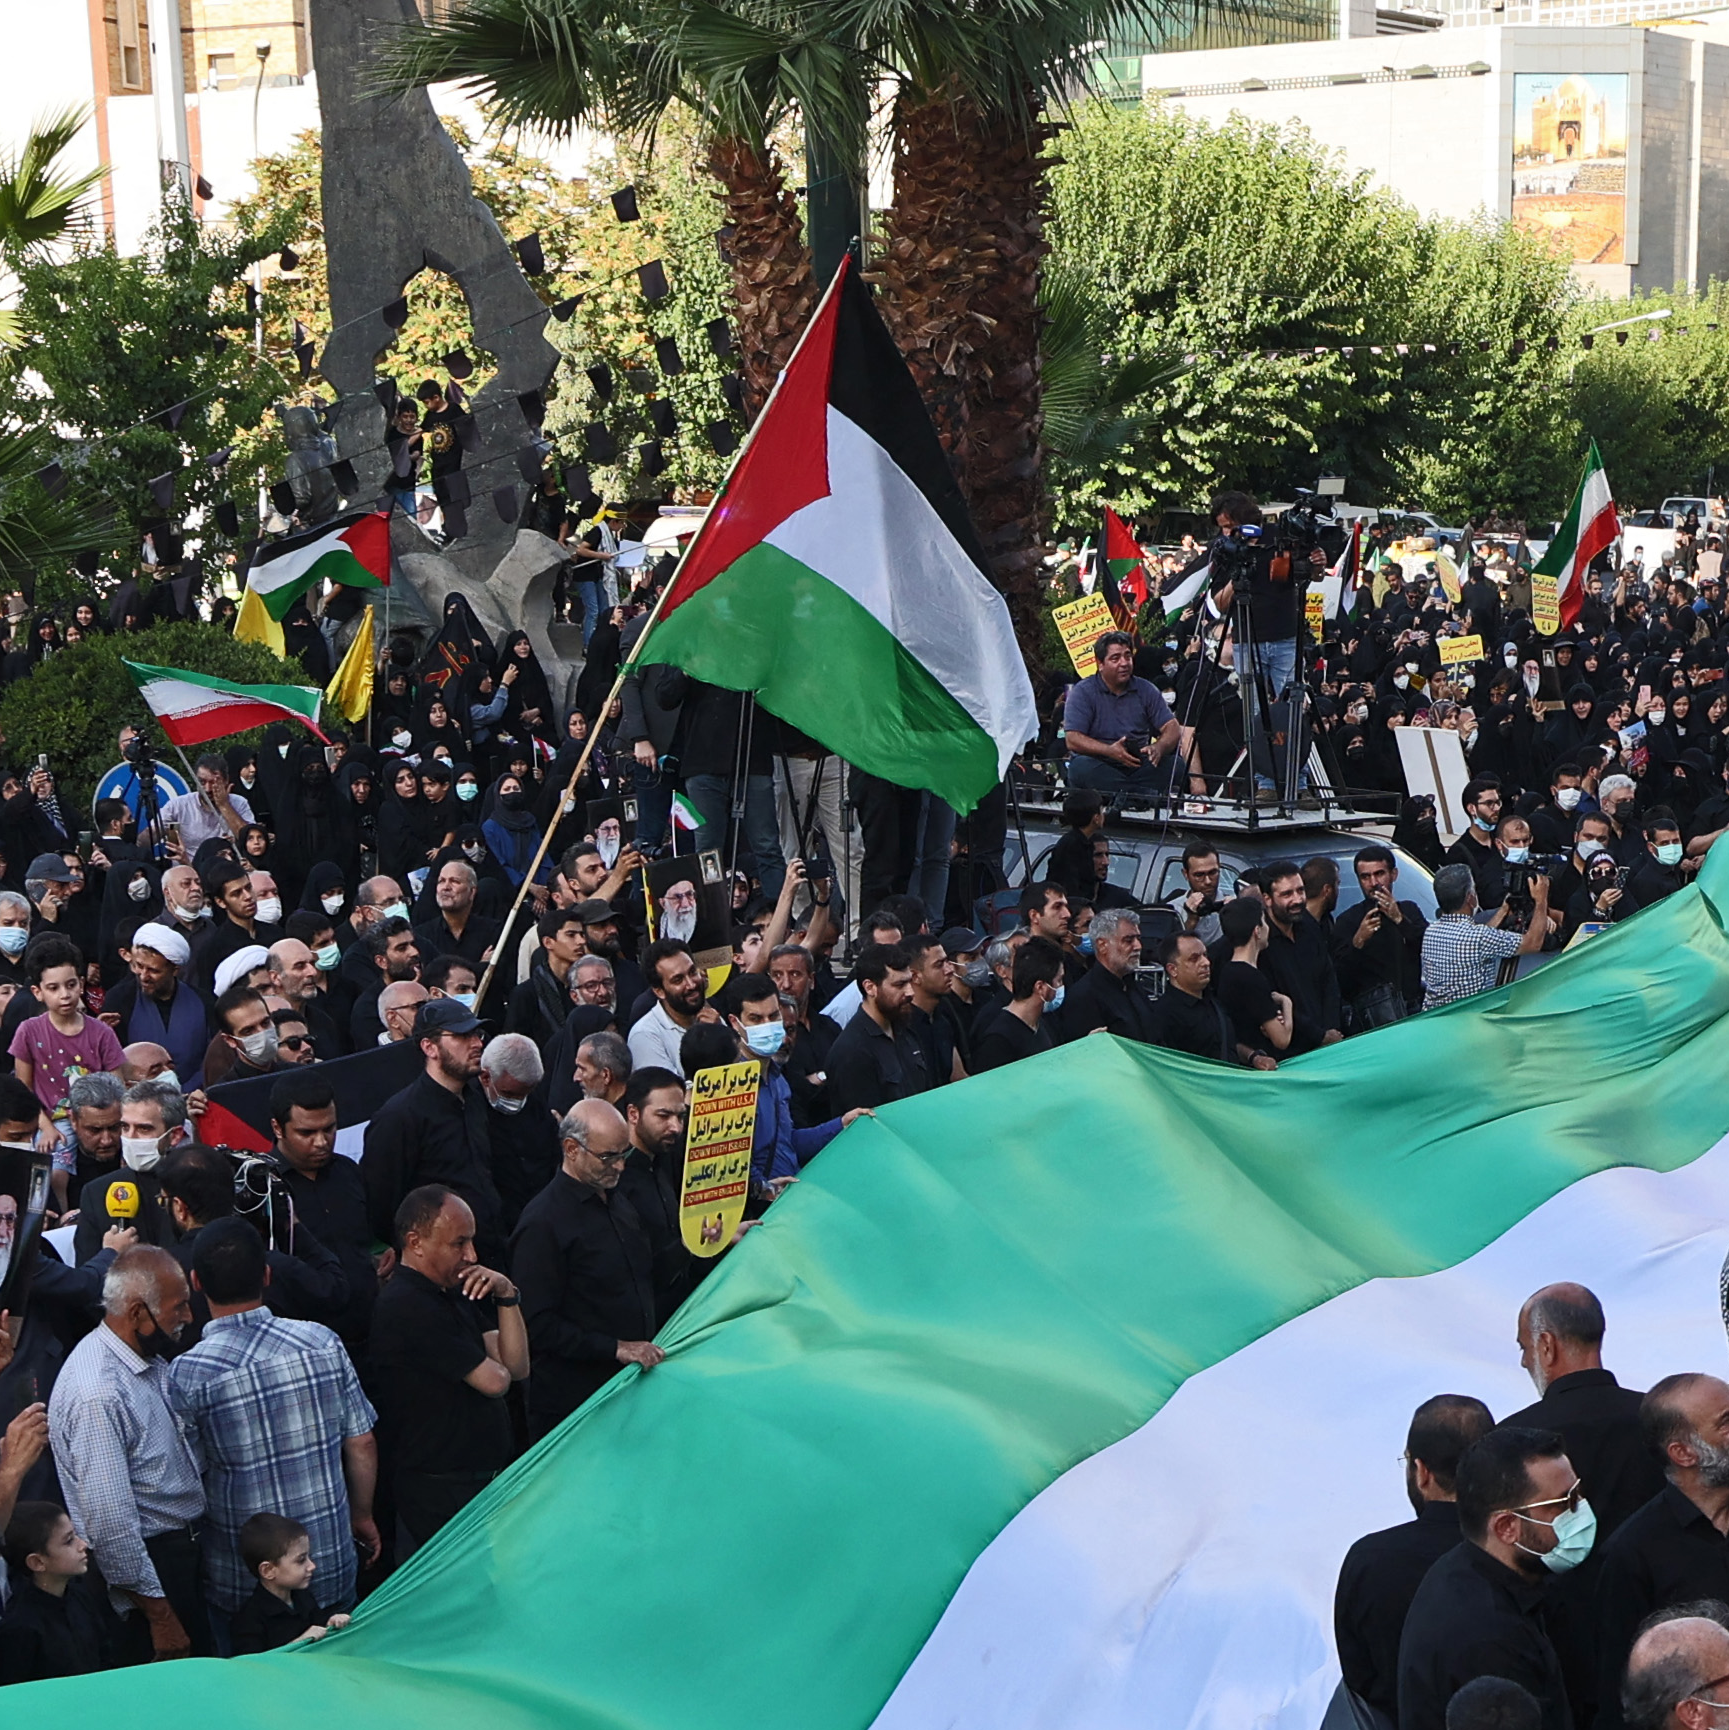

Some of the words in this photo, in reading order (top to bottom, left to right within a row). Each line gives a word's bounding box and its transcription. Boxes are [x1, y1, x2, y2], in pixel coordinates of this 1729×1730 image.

[696, 1067, 728, 1099] آمریکا
[727, 1073, 738, 1095] بر
[738, 1066, 758, 1092] مرگ
[694, 1100, 718, 1114] DOWN
[718, 1097, 737, 1111] WITH
[738, 1094, 755, 1107] U.S.A
[690, 1115, 724, 1143] اسرائیل
[725, 1118, 734, 1137] بر
[735, 1112, 753, 1134] مرگ
[689, 1146, 710, 1160] DOWN
[711, 1143, 728, 1156] WITH
[728, 1138, 750, 1153] ISRAEL
[686, 1162, 718, 1189] انگلیس
[719, 1164, 727, 1180] بر
[729, 1158, 748, 1174] مرگ
[684, 1191, 704, 1204] DOWN
[704, 1188, 719, 1201] WITH
[719, 1183, 744, 1198] ENGLAND
